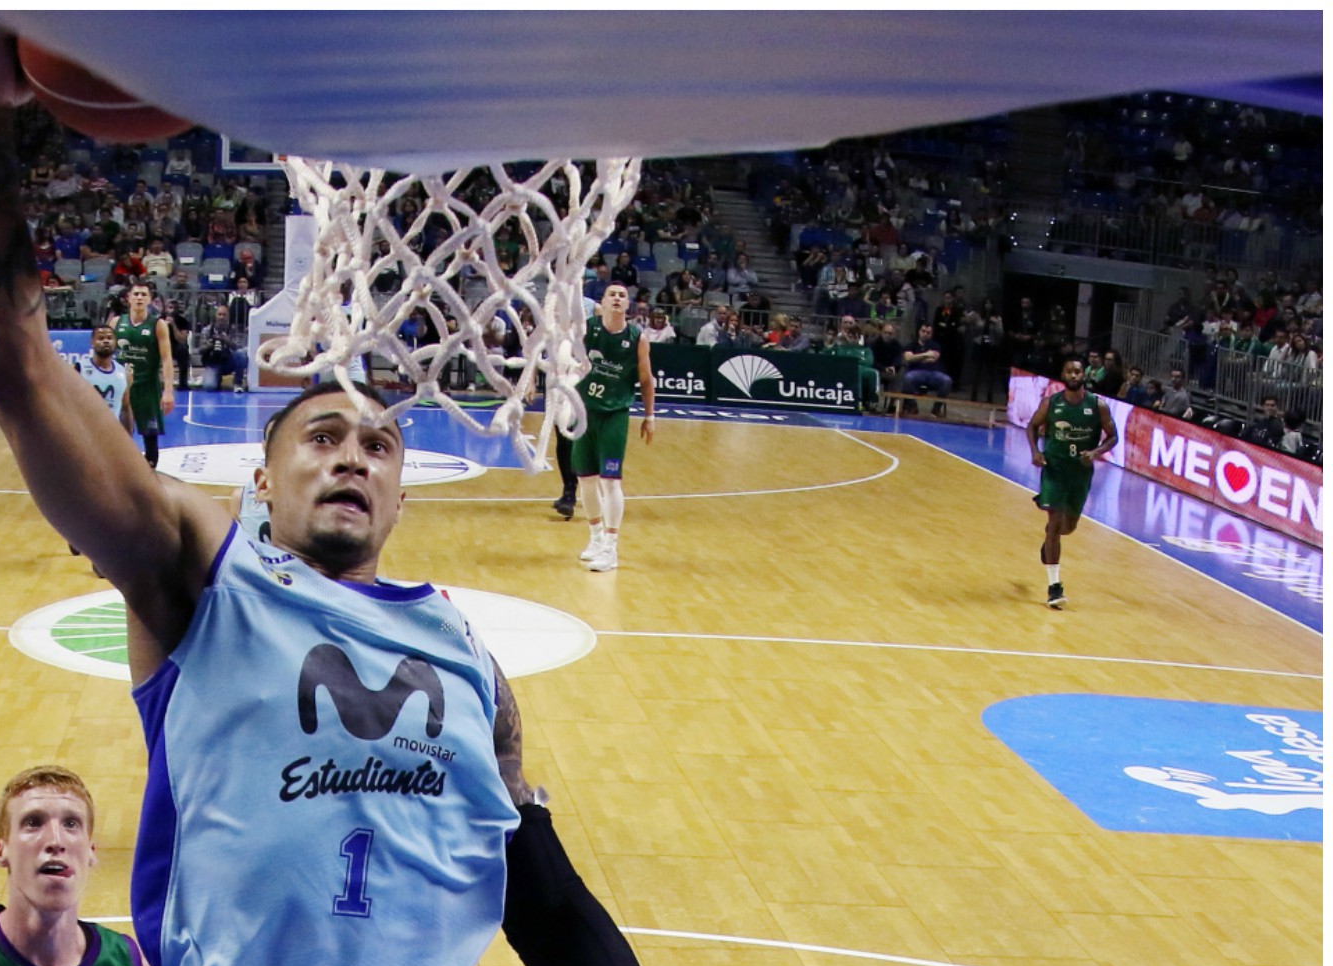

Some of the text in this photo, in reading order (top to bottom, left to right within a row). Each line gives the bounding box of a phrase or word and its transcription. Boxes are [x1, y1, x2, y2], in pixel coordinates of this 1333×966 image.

[587, 381, 606, 399] 92
[778, 380, 855, 405] Unicaja
[1069, 443, 1078, 457] 8
[393, 735, 457, 763] movistar
[279, 756, 447, 802] Estudiantes
[333, 827, 375, 919] 1
